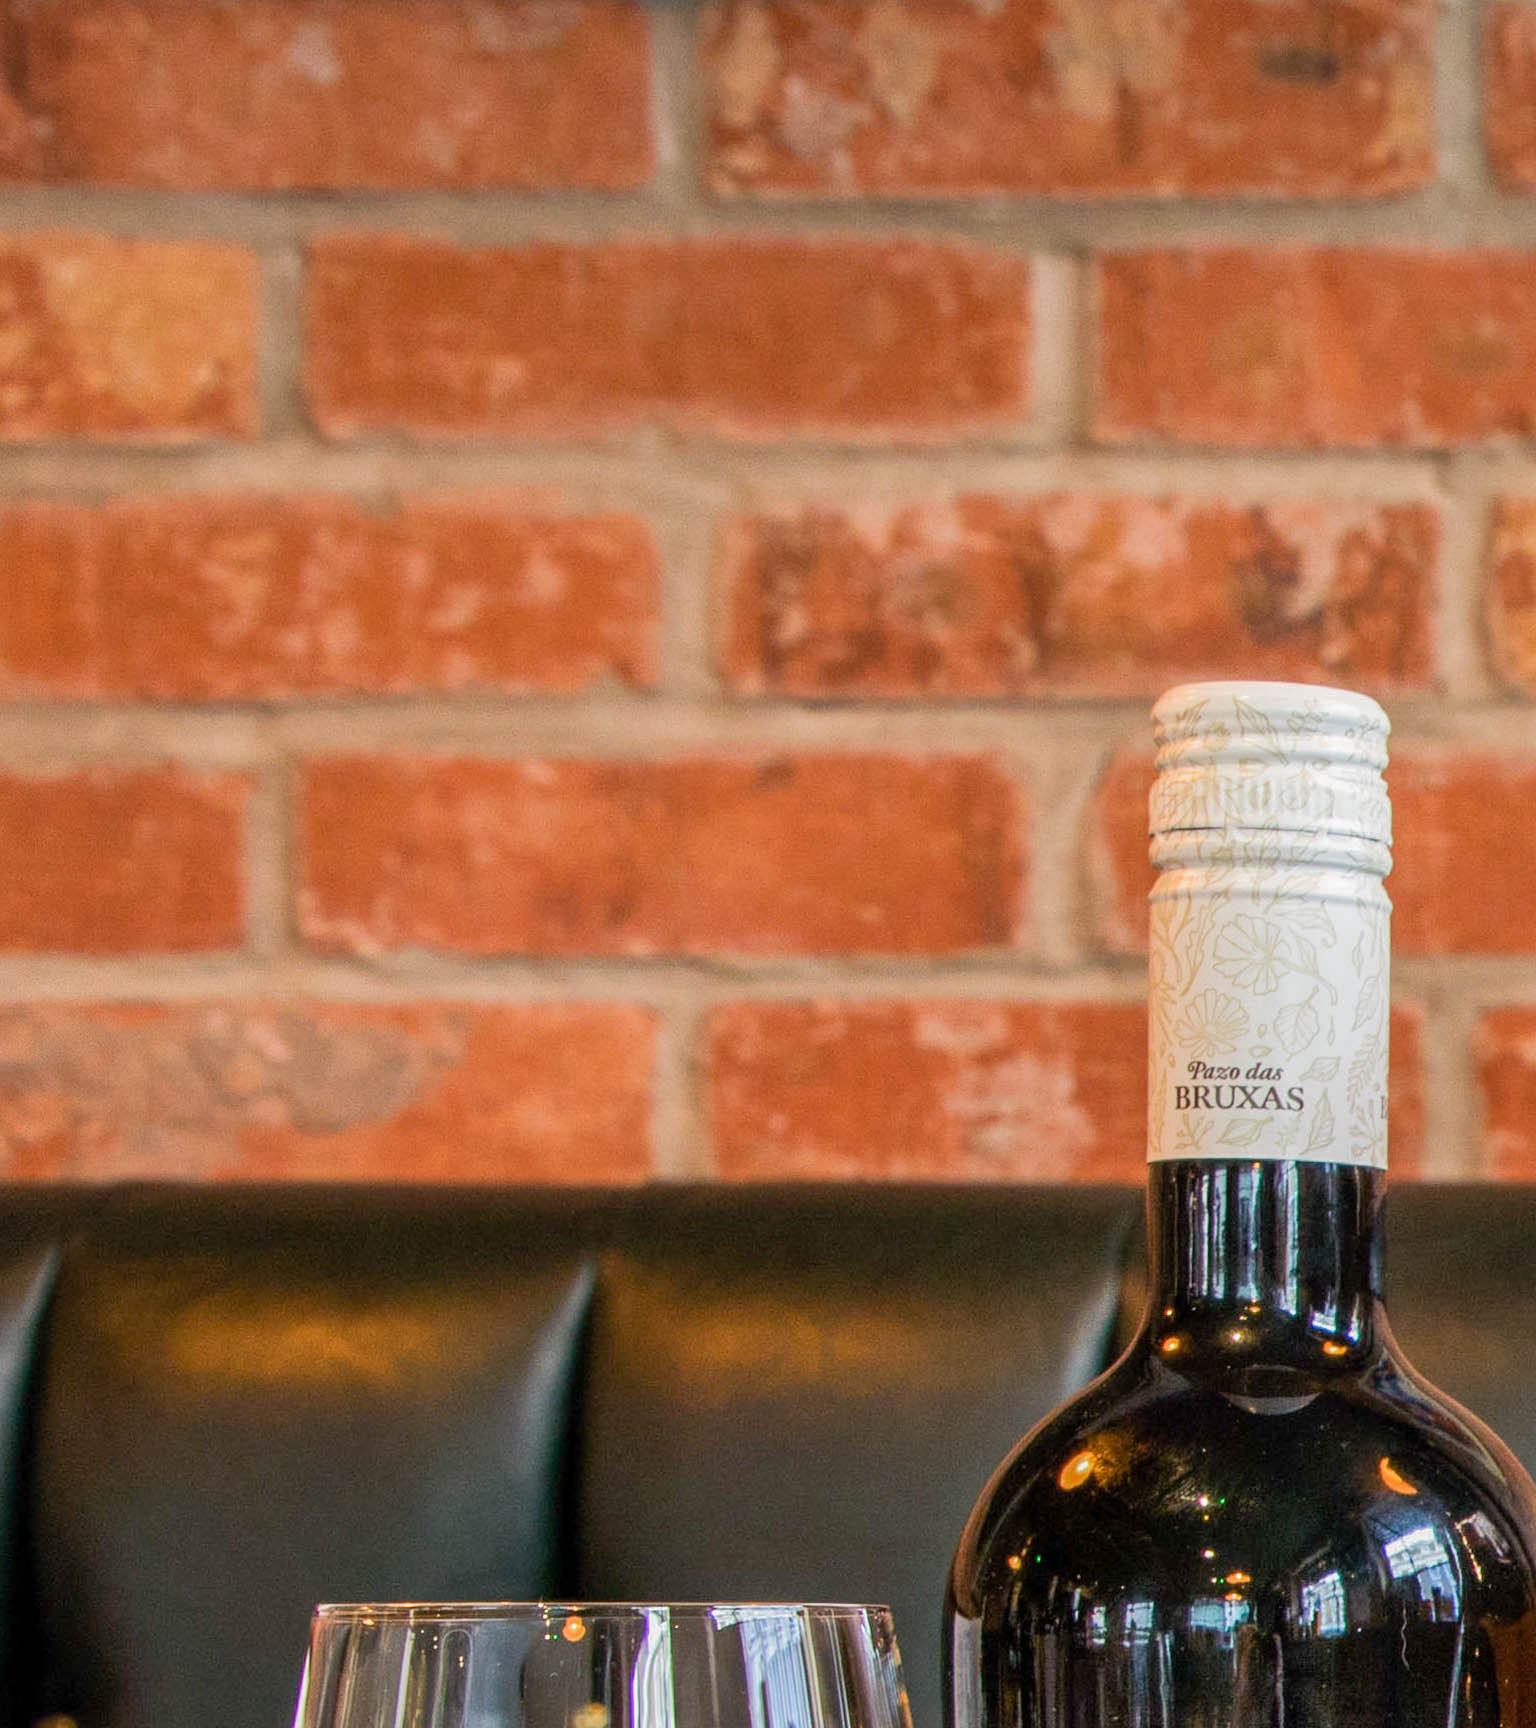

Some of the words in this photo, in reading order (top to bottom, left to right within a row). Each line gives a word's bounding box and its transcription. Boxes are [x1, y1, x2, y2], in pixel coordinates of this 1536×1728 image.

[1187, 1061, 1240, 1080] Pazo
[1245, 1063, 1284, 1081] das
[1175, 1085, 1305, 1111] BRUXAS
